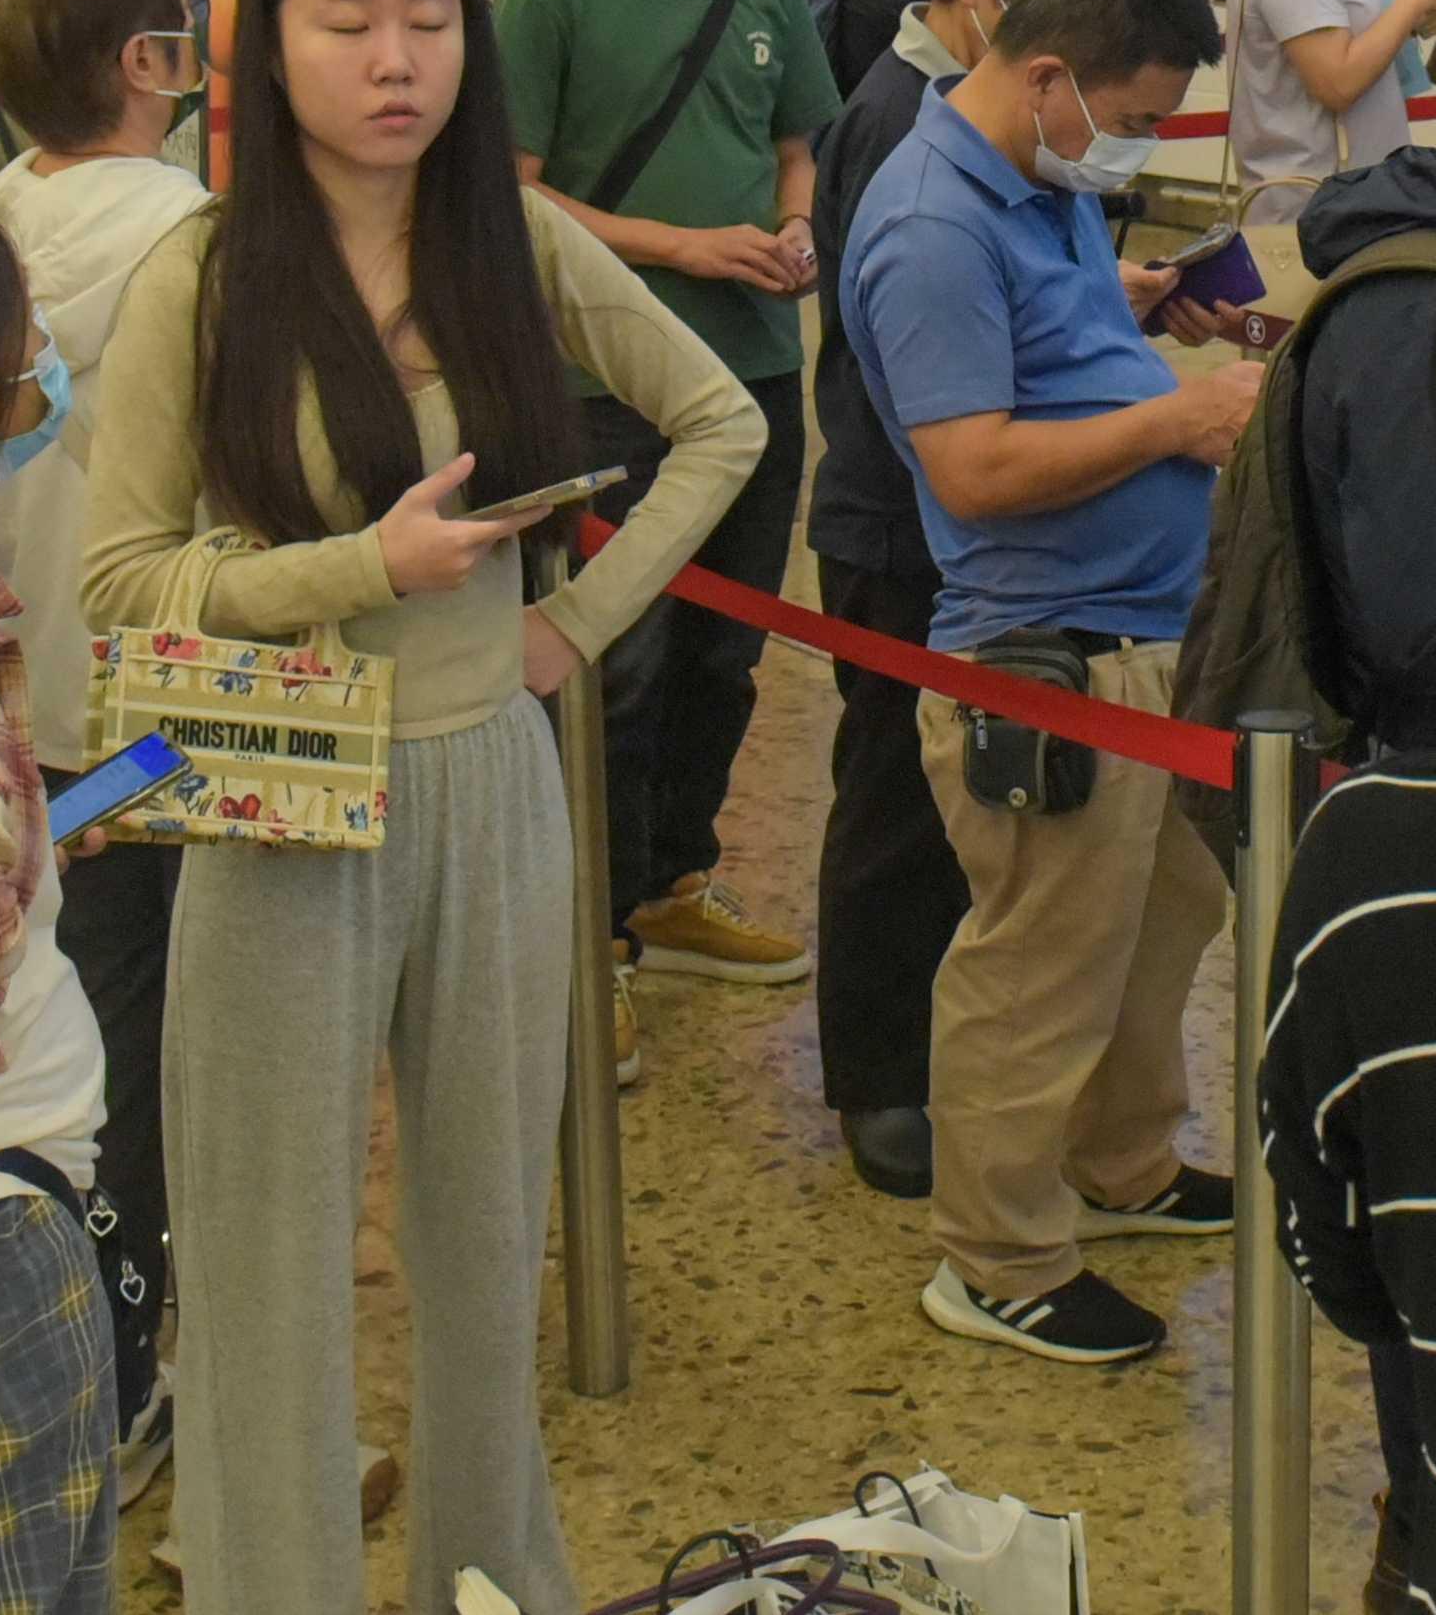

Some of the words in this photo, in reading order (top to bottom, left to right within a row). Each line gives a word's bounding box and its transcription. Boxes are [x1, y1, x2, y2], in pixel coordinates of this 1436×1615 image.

[754, 42, 770, 65] D
[158, 715, 278, 754] CHRISTIAN
[287, 729, 338, 761] DIOR
